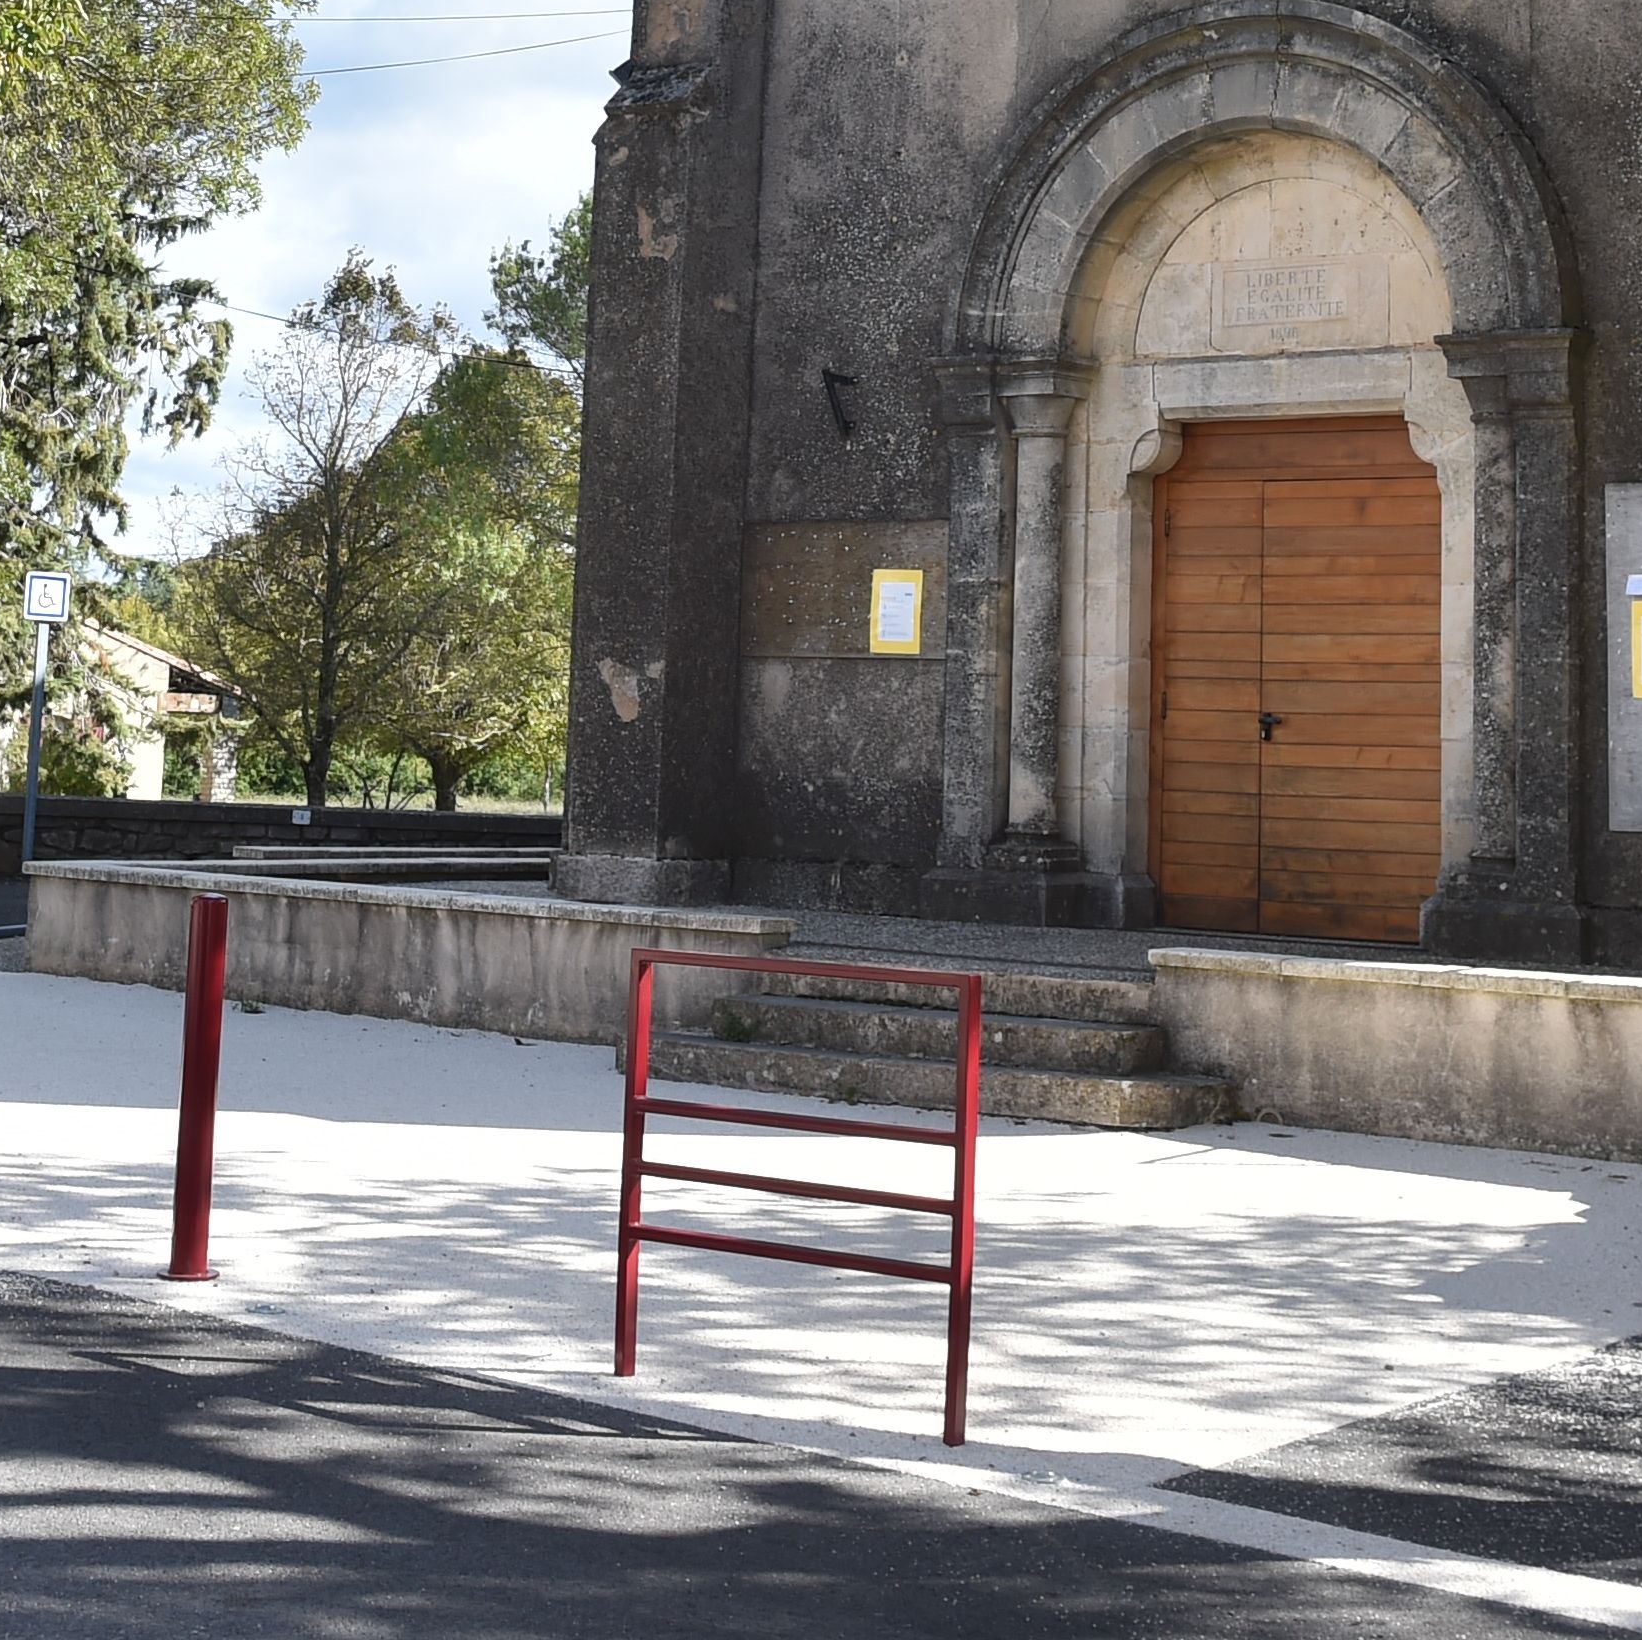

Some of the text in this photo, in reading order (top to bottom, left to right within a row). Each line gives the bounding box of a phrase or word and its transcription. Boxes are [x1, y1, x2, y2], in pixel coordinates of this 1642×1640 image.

[1246, 269, 1326, 289] LIBERTE
[1247, 285, 1326, 305] EGALITE
[1235, 300, 1344, 321] FRATERNITE
